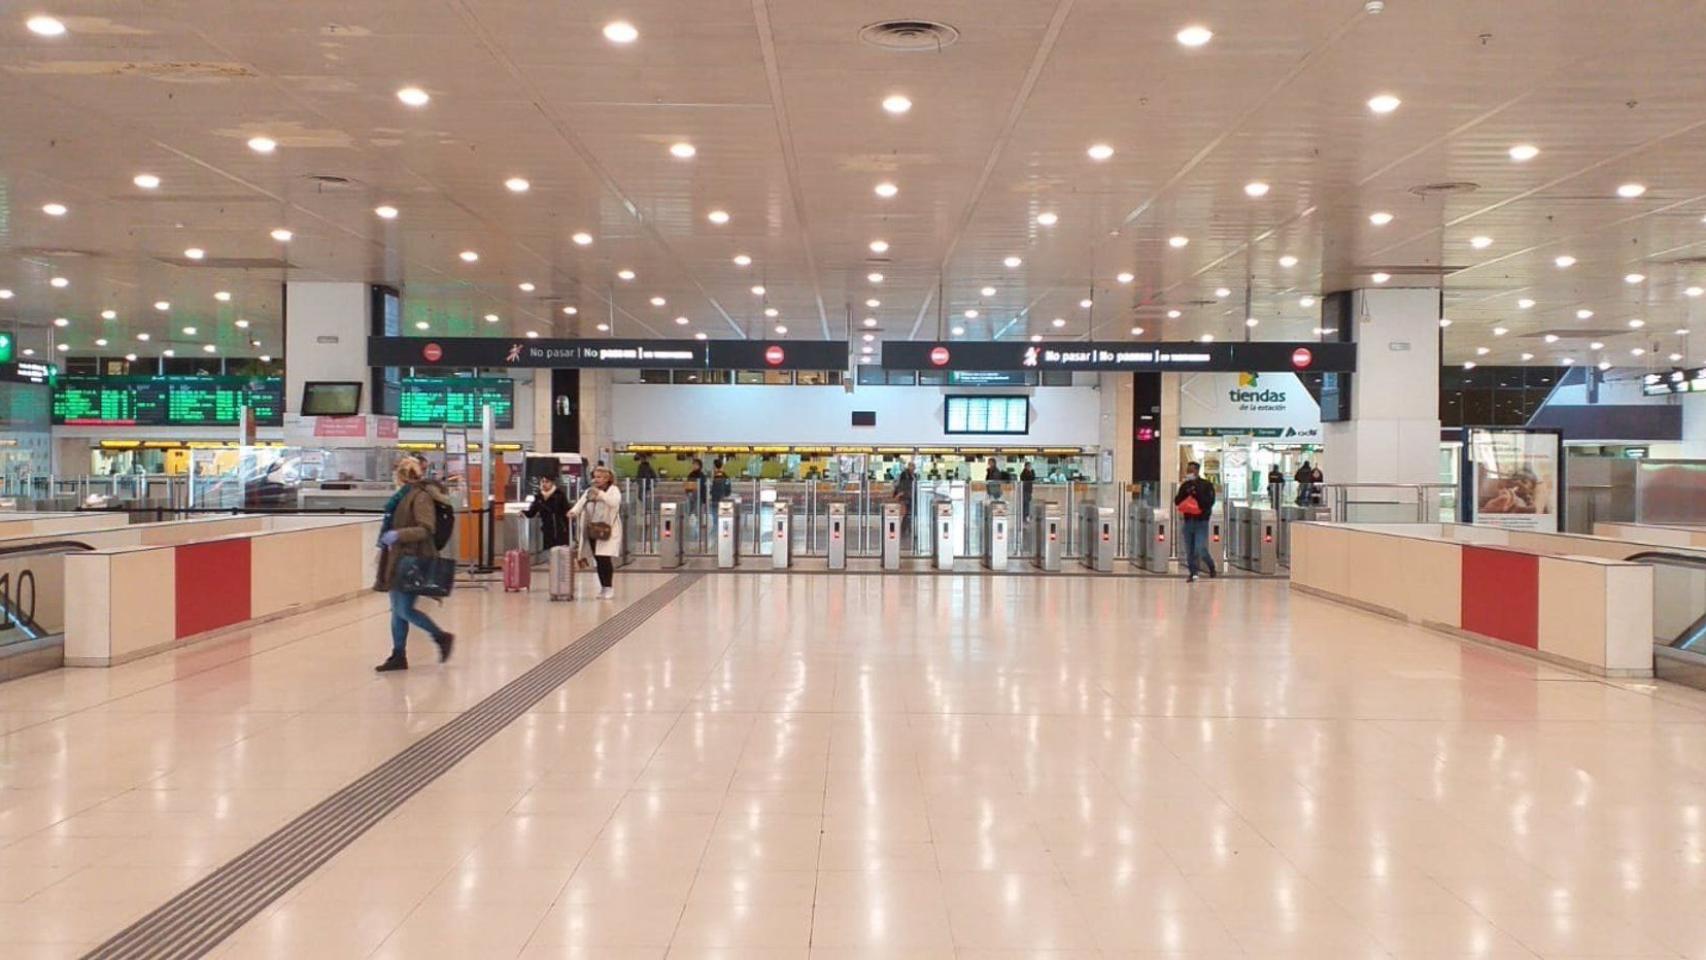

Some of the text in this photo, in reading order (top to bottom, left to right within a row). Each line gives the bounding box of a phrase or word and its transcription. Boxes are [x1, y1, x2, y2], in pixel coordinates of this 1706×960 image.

[530, 347, 544, 358] No
[547, 348, 575, 360] pasar
[584, 347, 599, 358] No
[1062, 351, 1091, 364] pasar
[1229, 389, 1286, 402] tiendas
